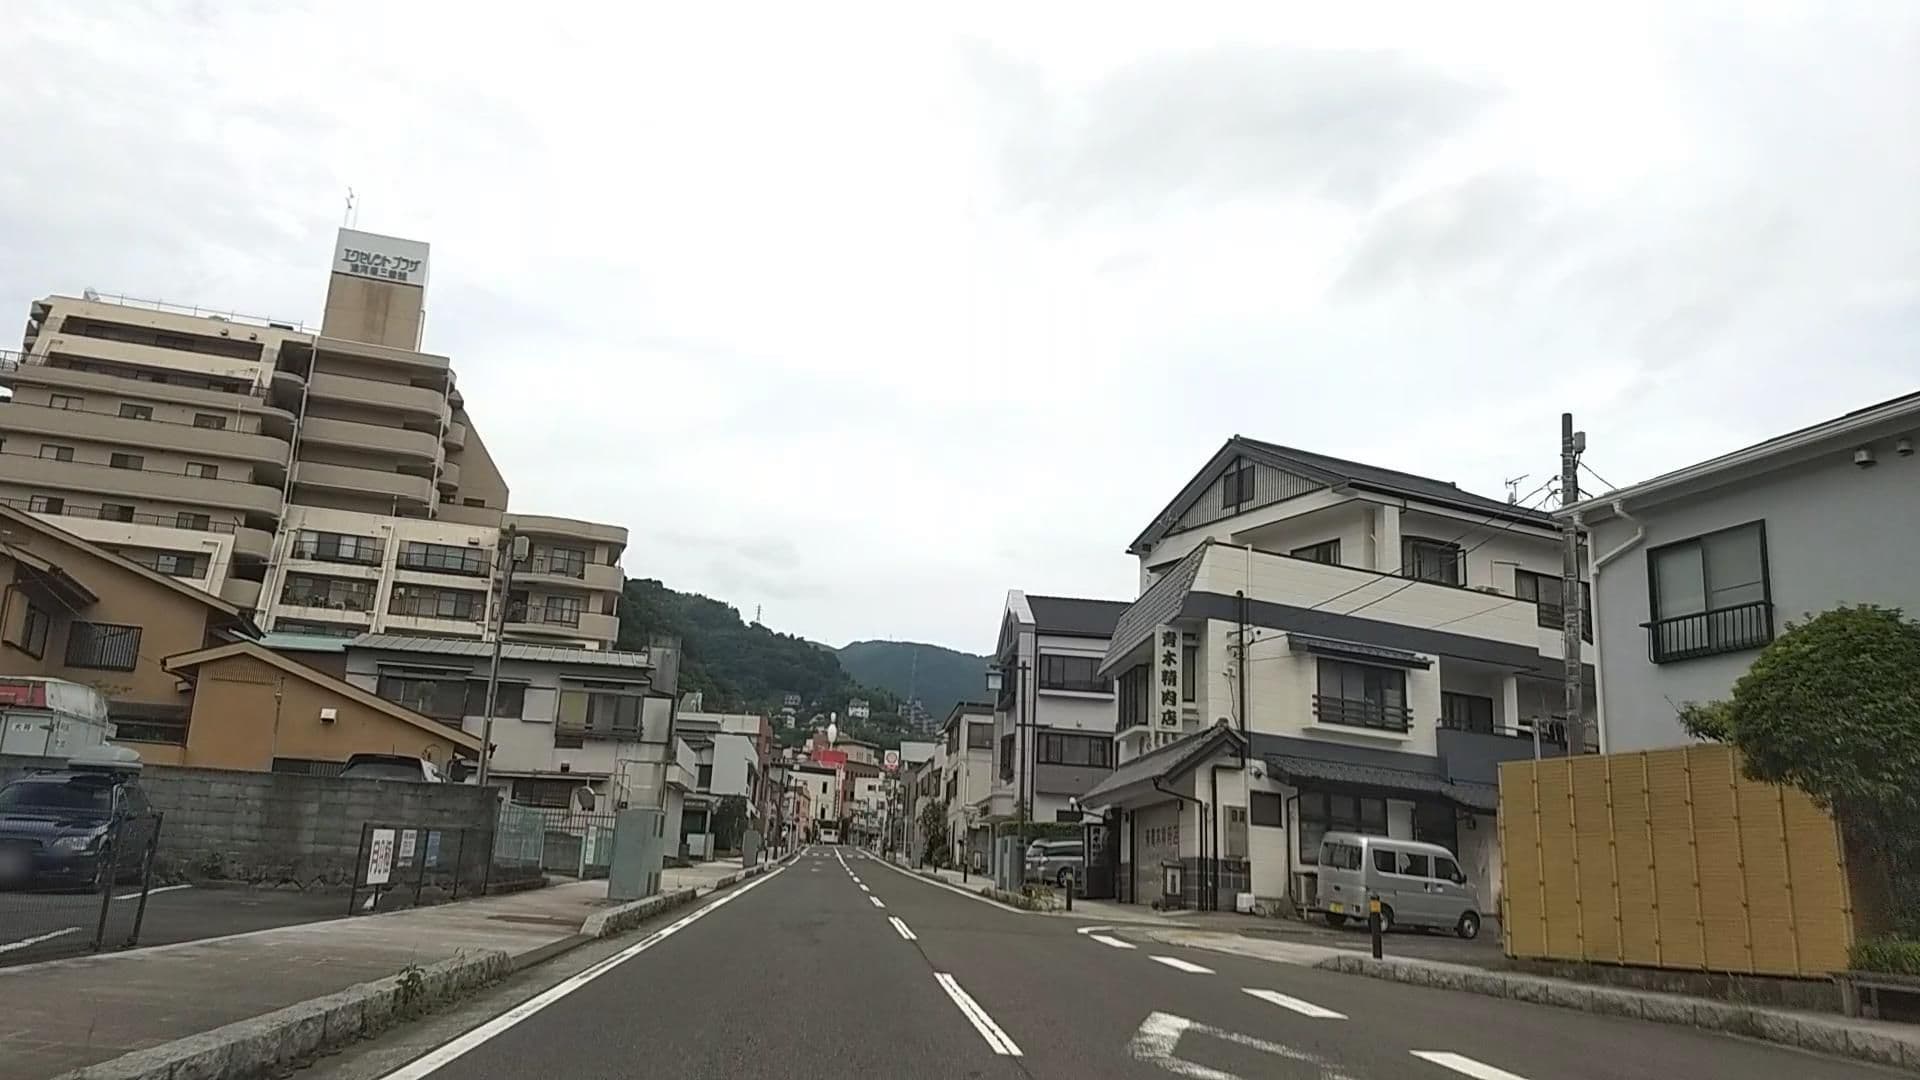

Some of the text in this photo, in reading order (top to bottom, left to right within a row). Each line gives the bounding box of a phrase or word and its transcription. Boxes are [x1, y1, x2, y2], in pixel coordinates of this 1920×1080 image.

[1161, 630, 1177, 727] 青木精肉店
